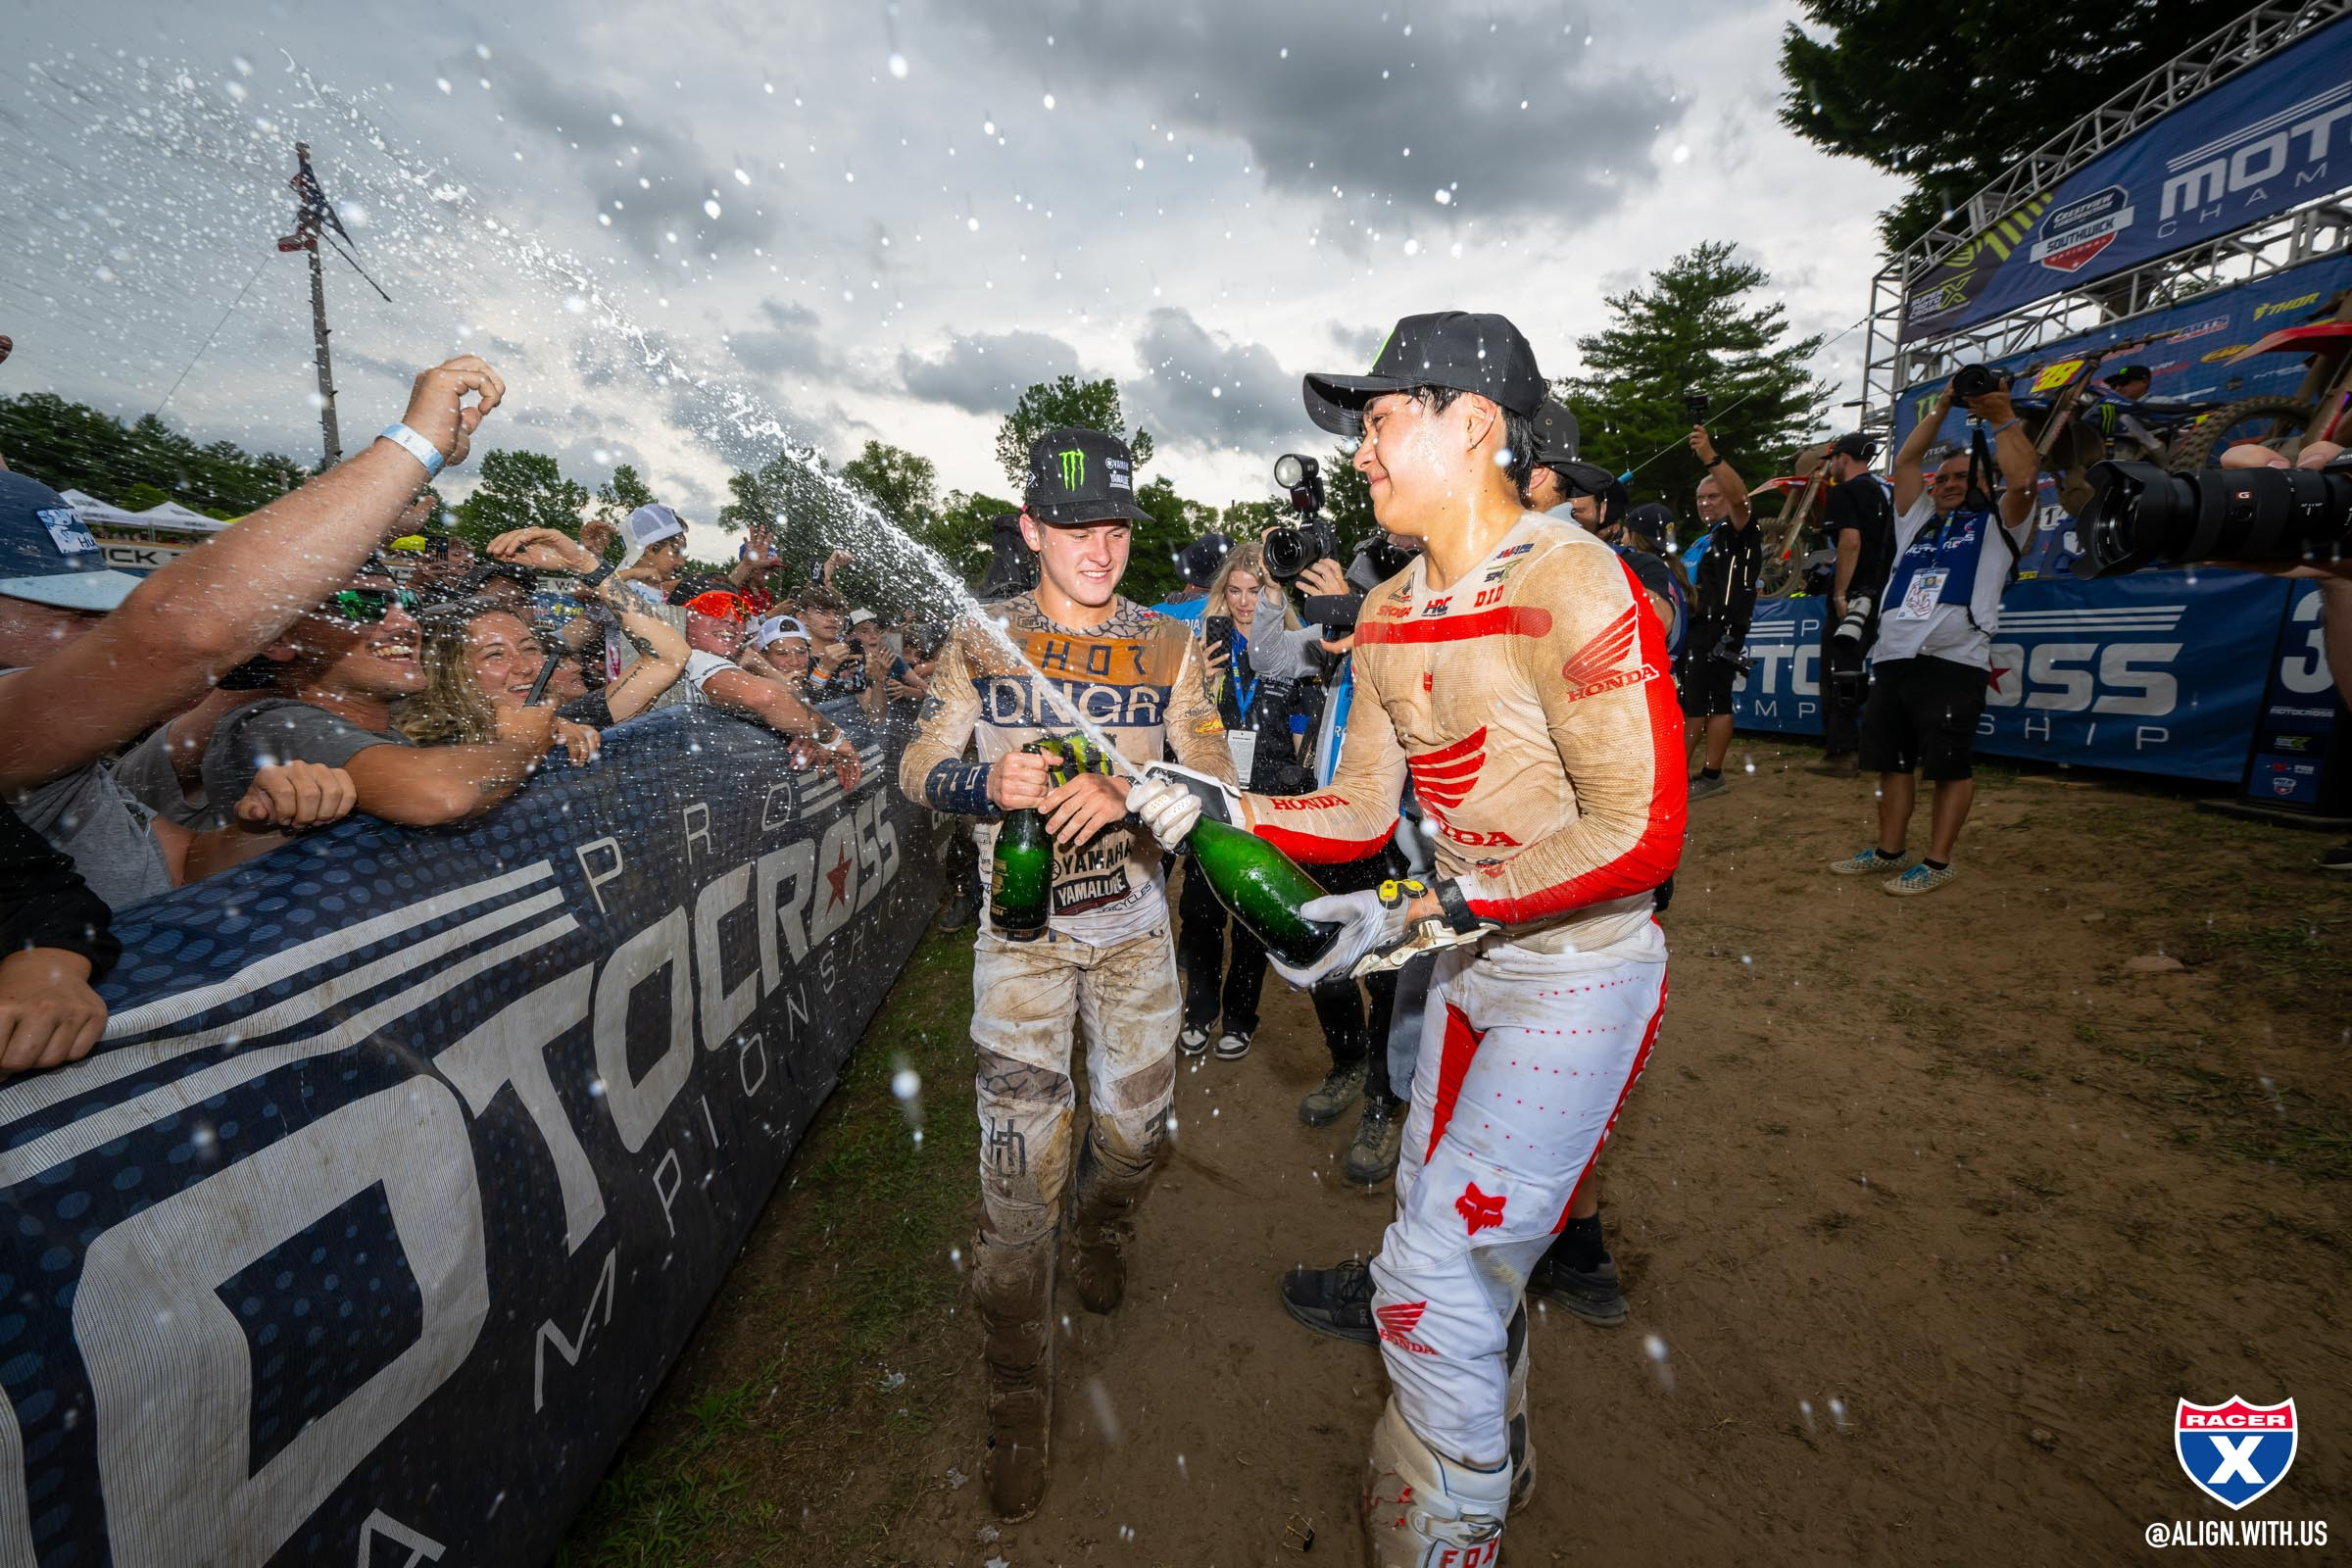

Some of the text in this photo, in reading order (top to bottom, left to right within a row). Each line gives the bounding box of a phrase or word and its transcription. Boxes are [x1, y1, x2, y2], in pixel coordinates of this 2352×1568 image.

[2159, 103, 2352, 221] MOT
[2045, 217, 2116, 254] SOUTHWICK
[2267, 292, 2322, 317] THOR
[2178, 315, 2230, 335] ARTS
[1567, 666, 1658, 703] HONDA
[2270, 707, 2335, 717] MOTOCROSS
[1270, 794, 1350, 810] HONDA
[576, 783, 792, 914] PRO
[1063, 837, 1133, 875] YAMAHA
[1058, 872, 1127, 906] YAMALUBE
[0, 787, 900, 1568] OTOCROSS
[1378, 1328, 1441, 1356] HONDA
[1442, 1537, 1499, 1568] FOX
